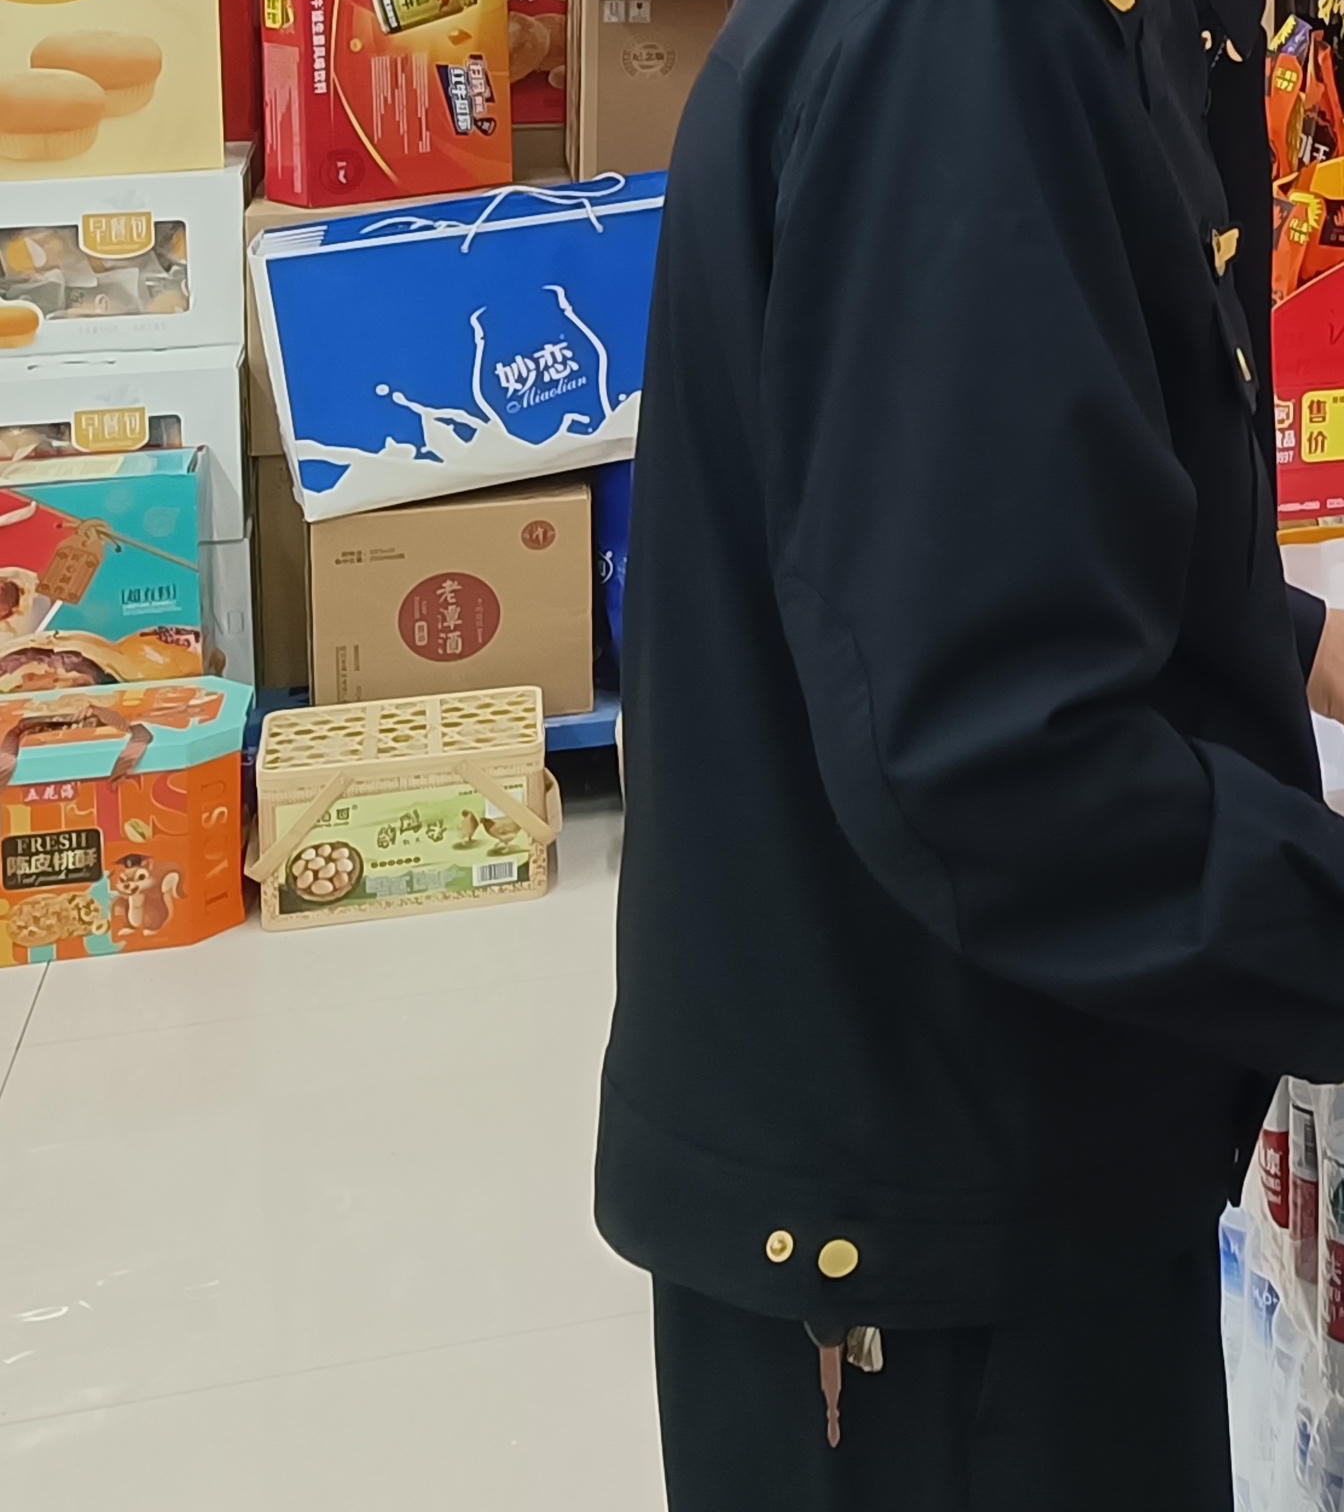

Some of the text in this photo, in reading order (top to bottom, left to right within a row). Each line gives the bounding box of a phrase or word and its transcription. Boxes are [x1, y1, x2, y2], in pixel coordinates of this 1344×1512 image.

[88, 216, 147, 243] 早餐包
[494, 341, 580, 399] 妙恋
[1307, 398, 1328, 455] 售价
[435, 578, 463, 656] 老潭酒
